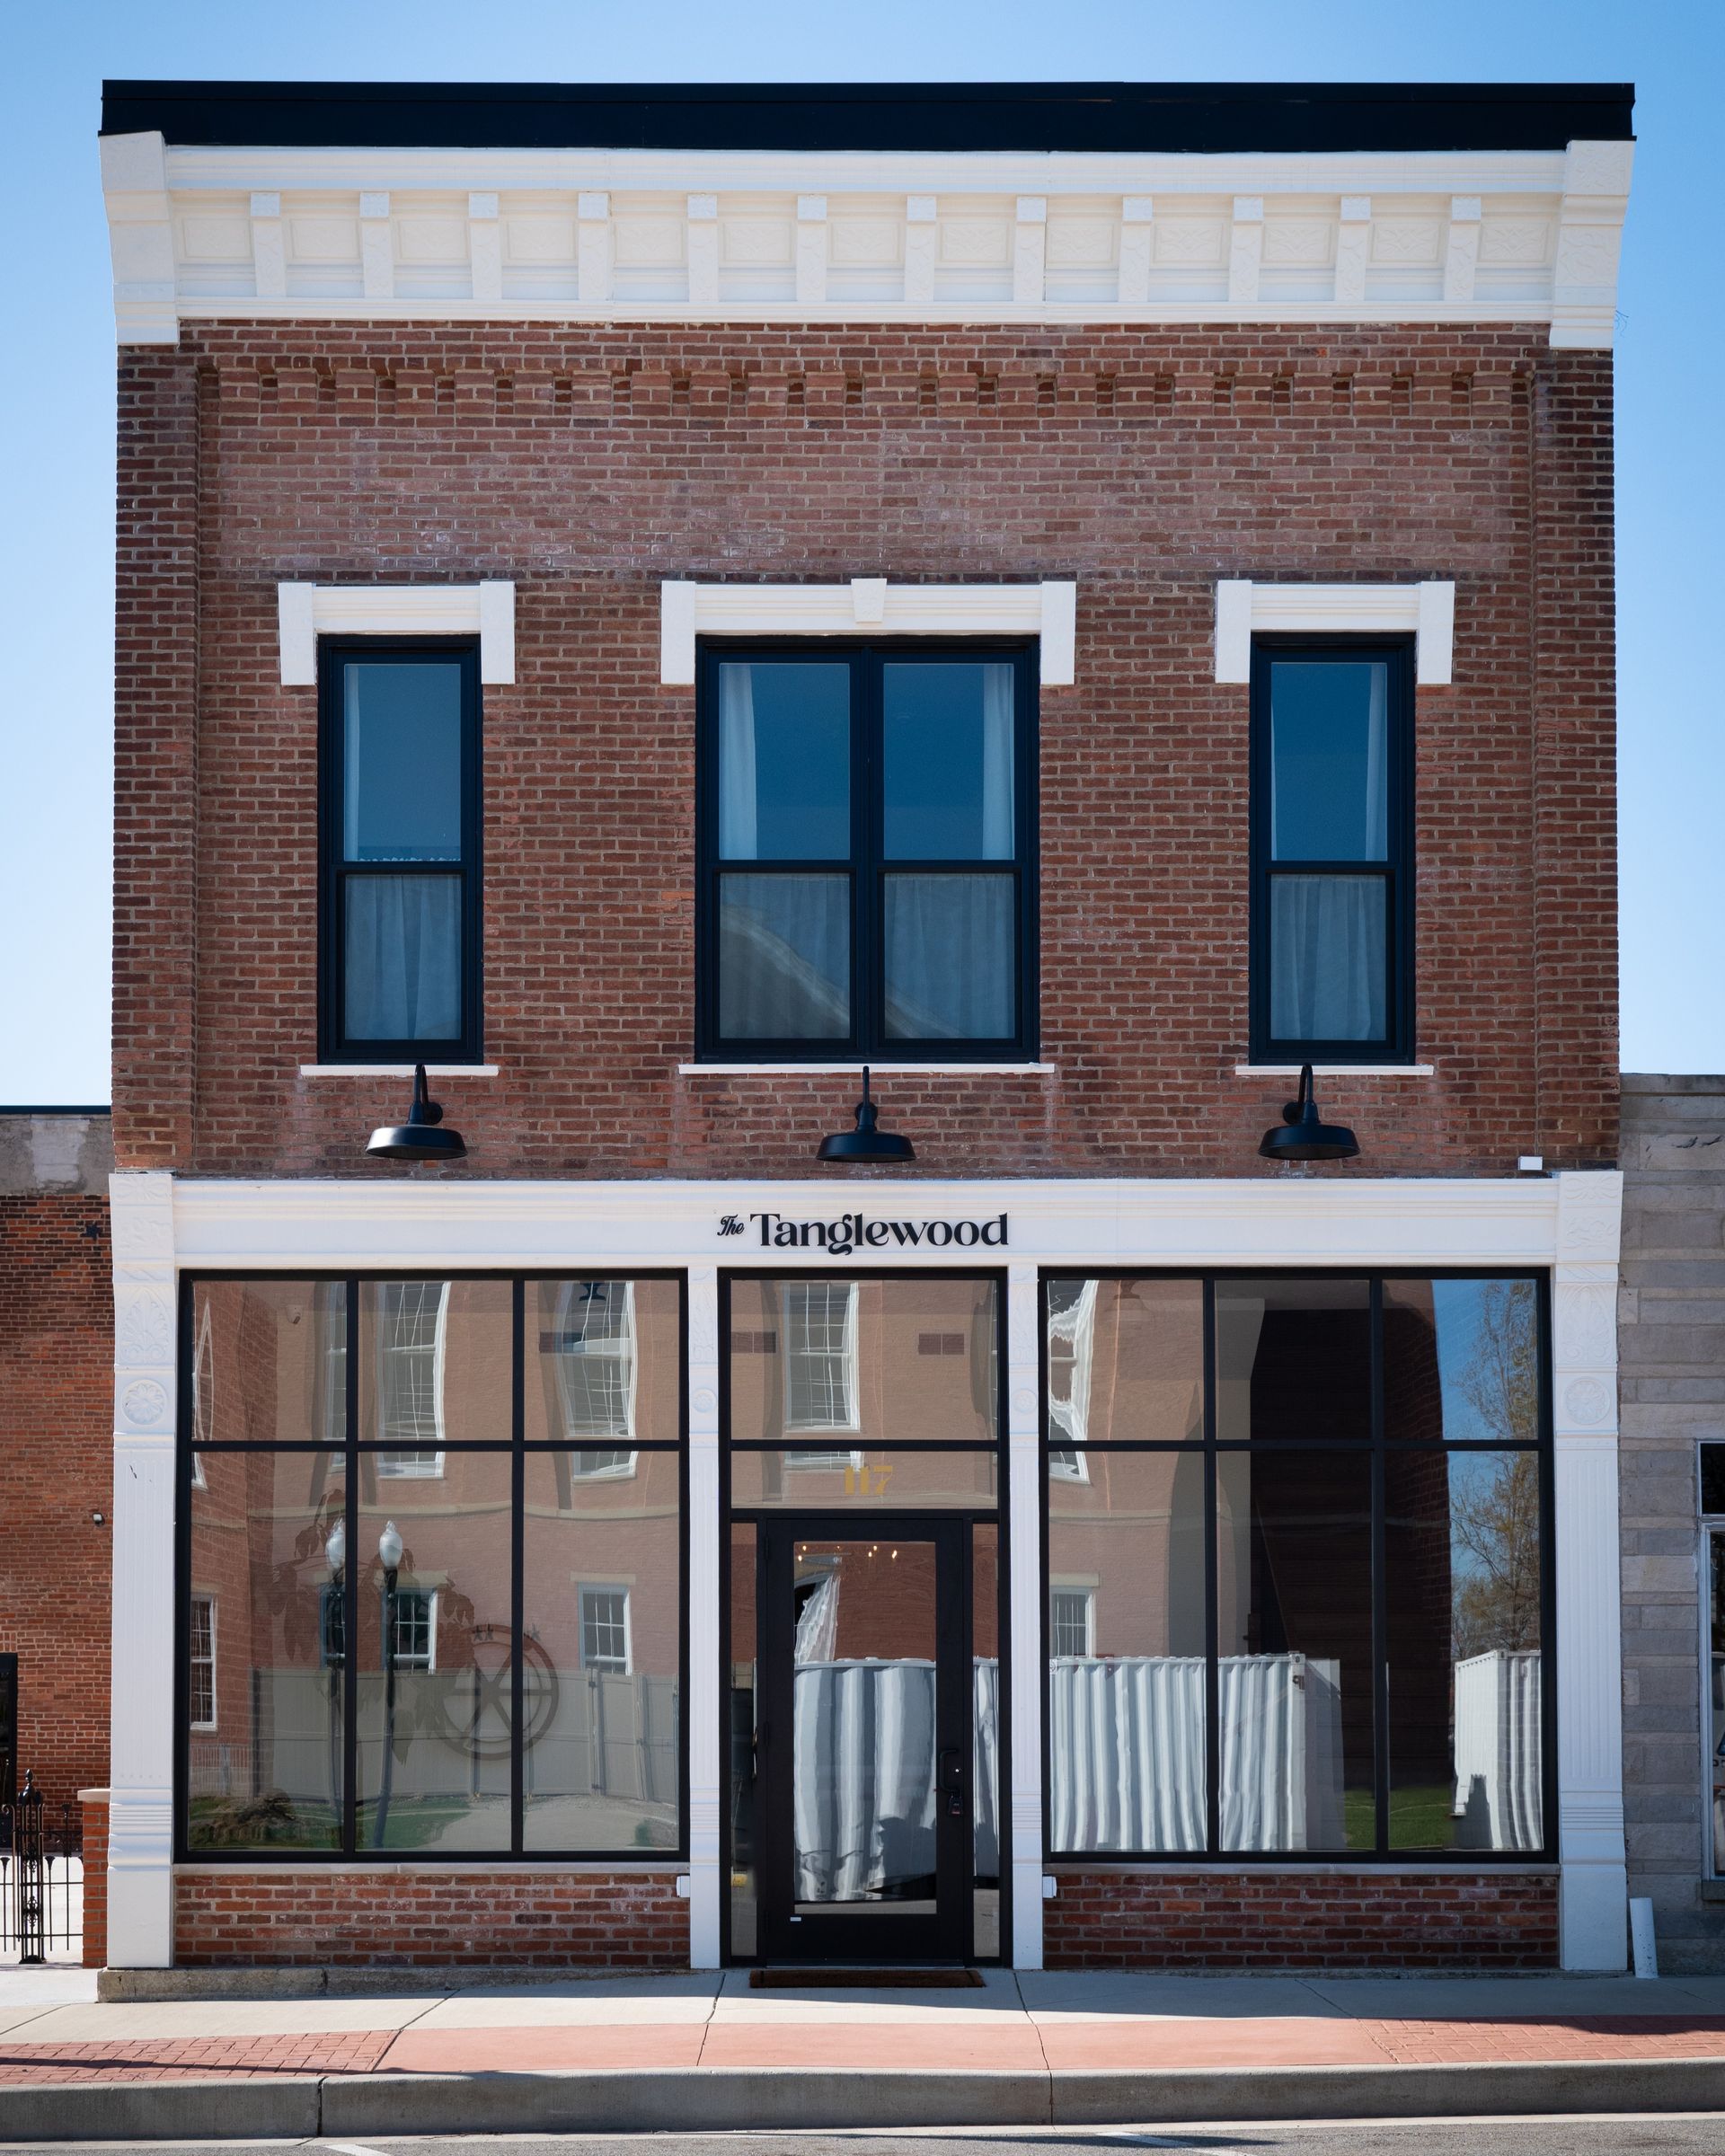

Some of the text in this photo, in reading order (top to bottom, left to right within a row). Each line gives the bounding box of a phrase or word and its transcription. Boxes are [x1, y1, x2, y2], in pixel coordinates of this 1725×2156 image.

[717, 1213, 1009, 1255] The Tanglewood
[845, 1465, 893, 1495] 117
